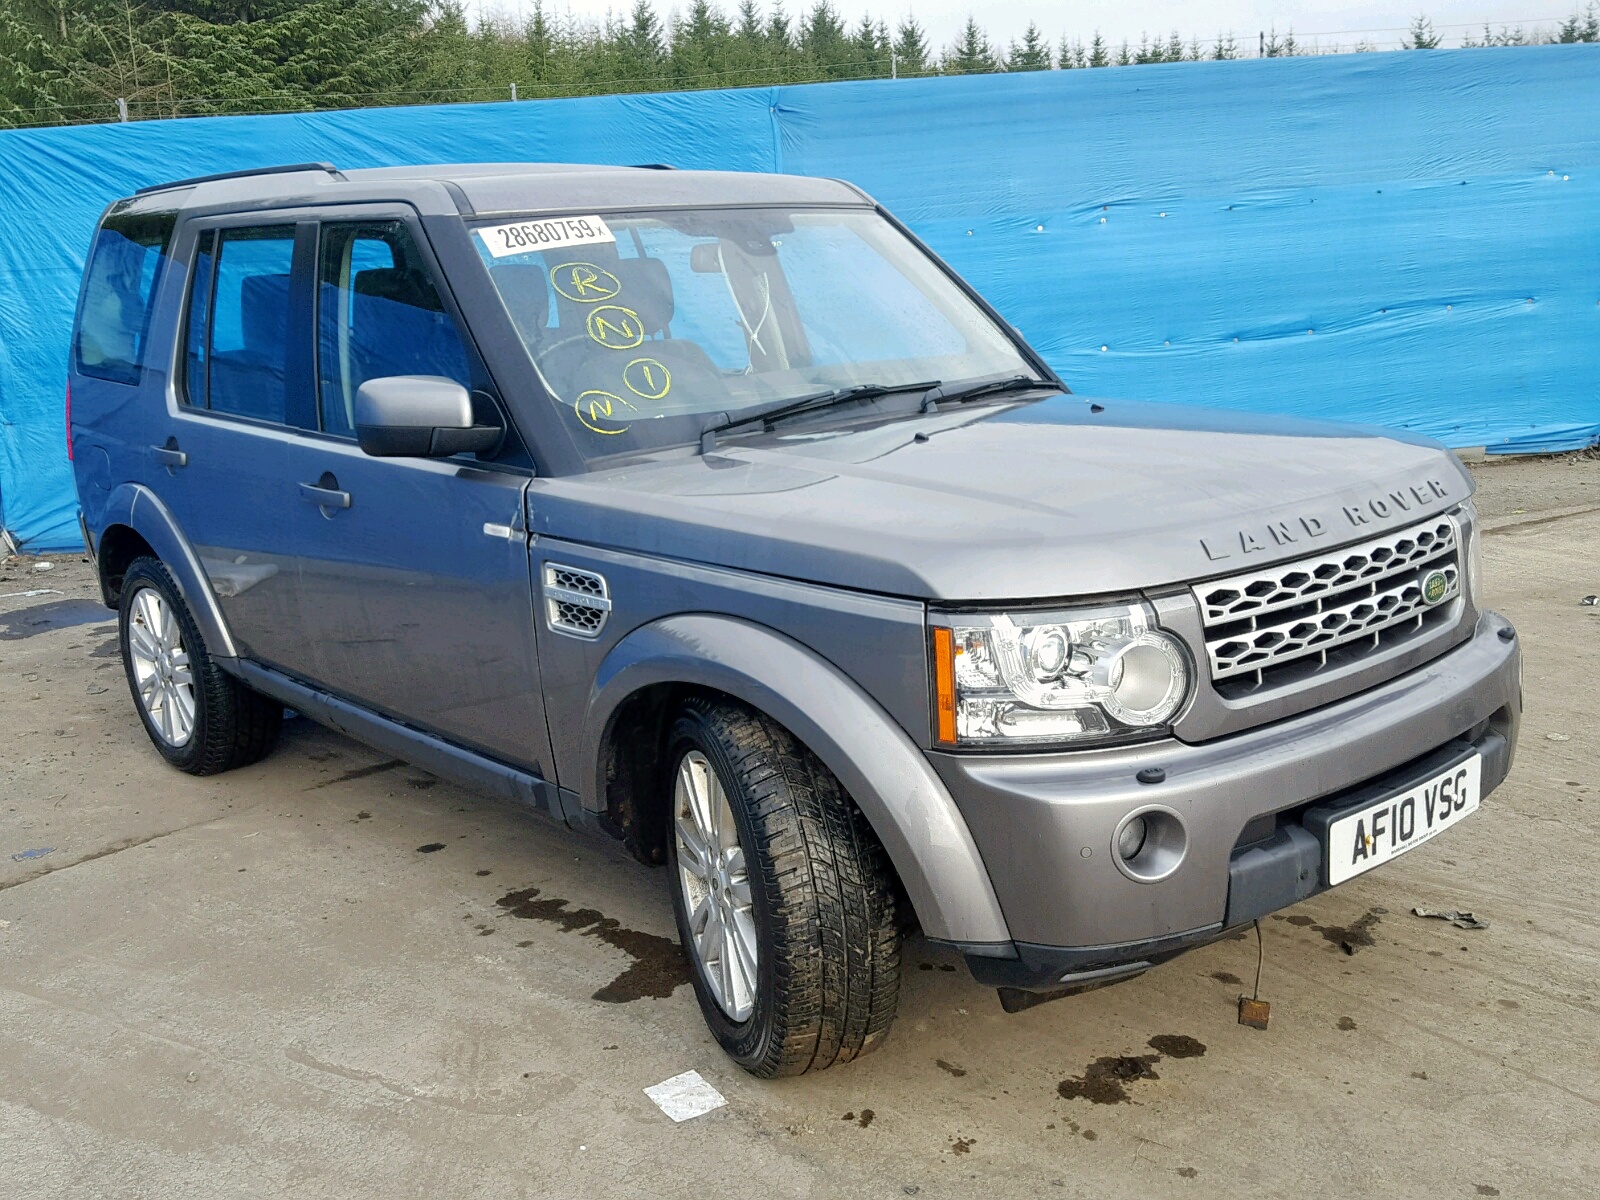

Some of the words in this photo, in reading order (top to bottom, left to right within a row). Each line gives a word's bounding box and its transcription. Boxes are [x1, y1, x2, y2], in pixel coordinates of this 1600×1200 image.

[497, 219, 595, 248] 28680759
[571, 267, 612, 295] R
[1200, 517, 1327, 560] LAND
[1342, 480, 1448, 526] ROVER
[1352, 796, 1415, 865] AF10
[1424, 768, 1467, 829] VSG
